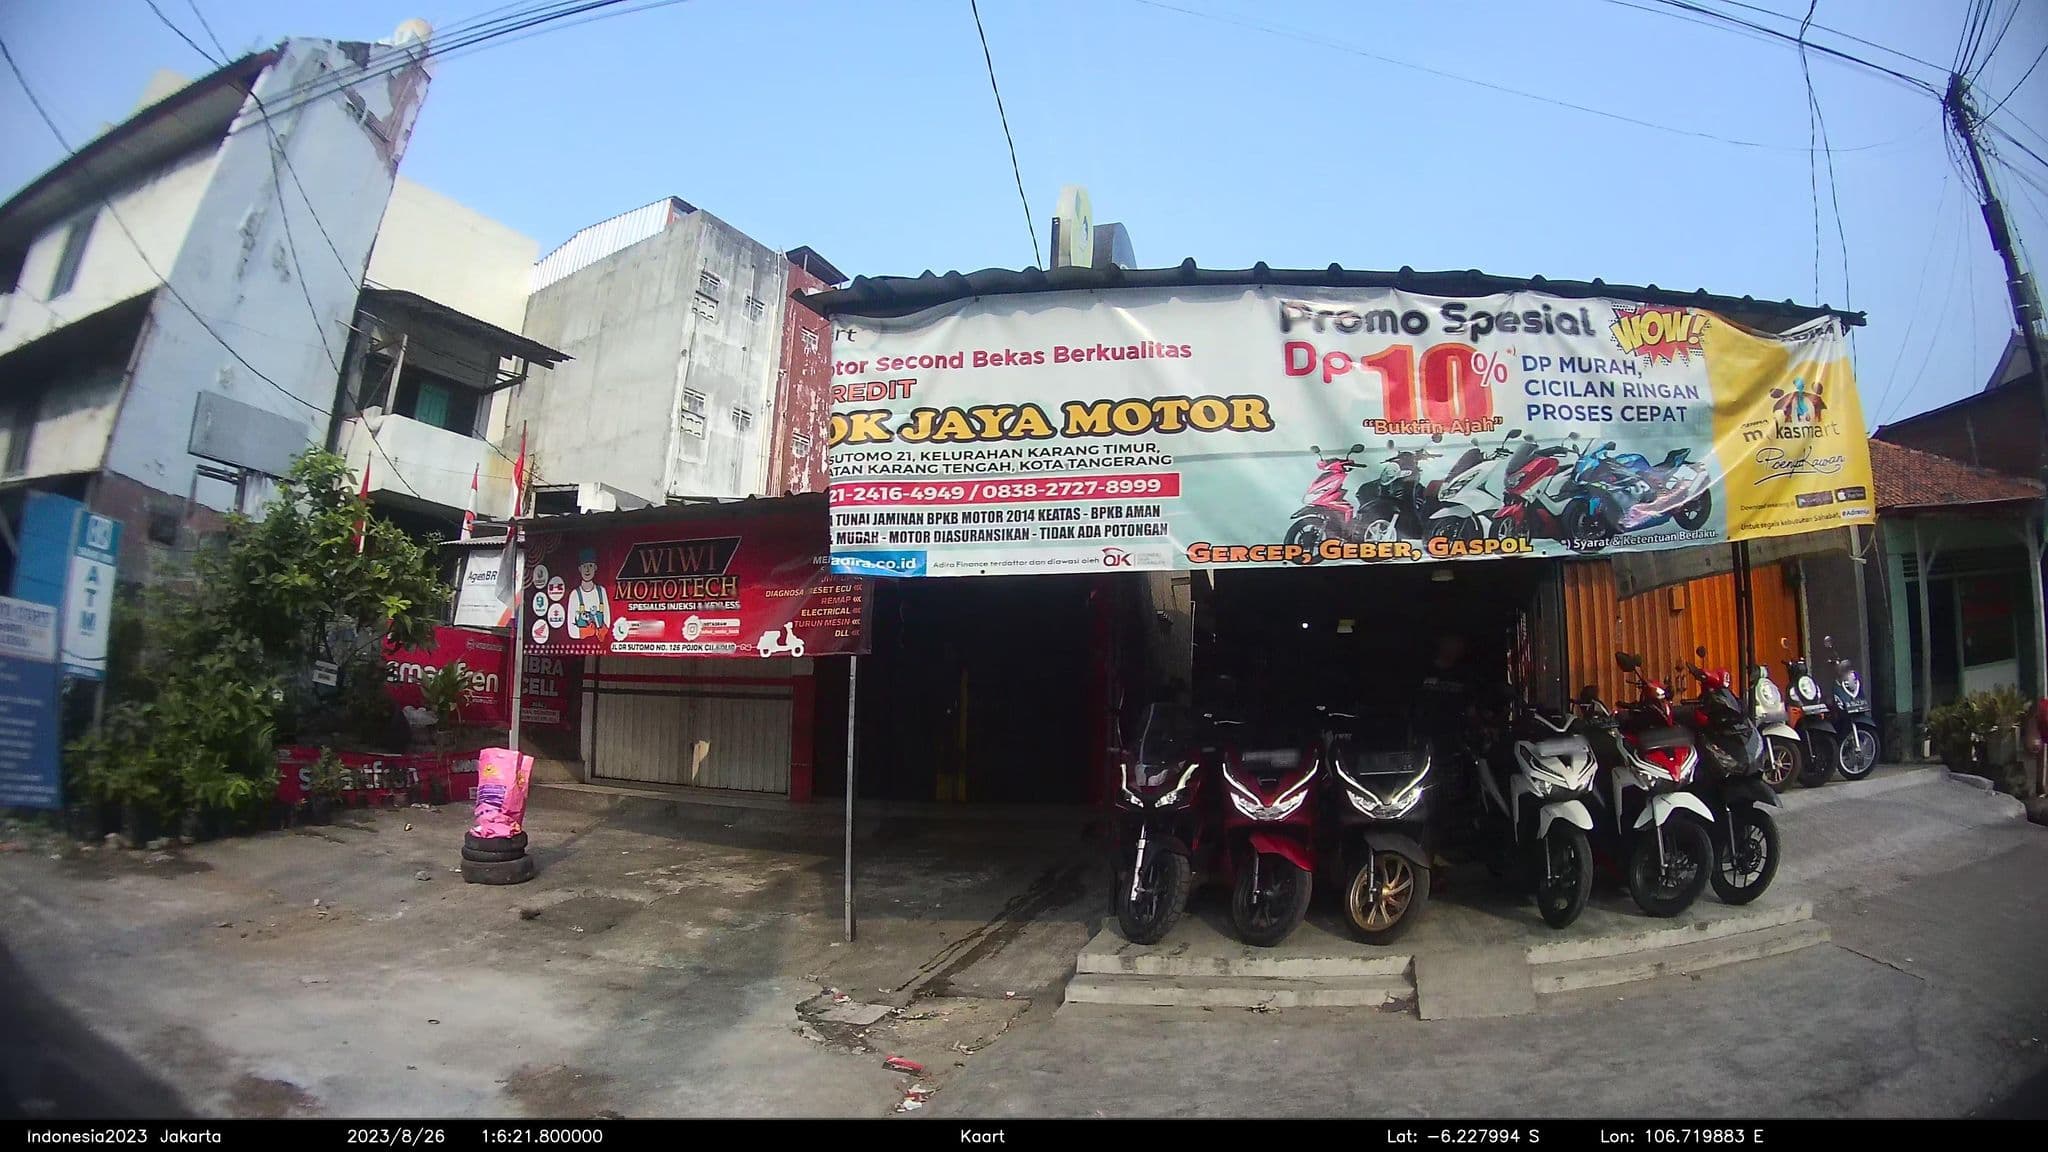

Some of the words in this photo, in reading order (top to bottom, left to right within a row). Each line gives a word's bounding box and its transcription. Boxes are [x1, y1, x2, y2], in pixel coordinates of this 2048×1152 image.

[1279, 301, 1430, 335] Promo
[1441, 302, 1596, 342] Spesial
[1610, 311, 1706, 354] WOW!
[832, 359, 868, 376] tor
[973, 349, 1045, 367] Bekas
[1054, 341, 1192, 364] Berkualitas
[1284, 340, 1353, 383] Dp
[1522, 355, 1551, 372] DP
[1560, 356, 1642, 378] MURAH,
[1525, 379, 1614, 397] CICILAN
[1623, 383, 1699, 399] RINGAN
[897, 403, 1058, 443] JAYA
[1061, 395, 1275, 438] MOTOR
[1527, 404, 1613, 422] PROSES
[1621, 406, 1687, 423] CEPAT
[1775, 420, 1840, 439] kasmart
[829, 452, 892, 465] SUTOMO
[897, 451, 915, 462] 21,
[920, 448, 1022, 462] KELURAHAN
[1028, 445, 1099, 458] KARANG
[1104, 443, 1160, 455] TIMUR,
[868, 463, 938, 474] KARANG
[943, 461, 1015, 475] TENGAH,
[1020, 459, 1063, 471] KOTA
[1067, 455, 1172, 469] TANGERANG
[982, 479, 1161, 499] 0838-2727-8999
[836, 513, 870, 527] TUNAI
[872, 512, 924, 526] JAMINAN
[927, 511, 958, 525] BPKB
[961, 511, 1003, 524] MOTOR
[1006, 510, 1035, 523] 2014
[1038, 508, 1081, 521] KEATAS
[1091, 506, 1123, 520] BPKB
[1126, 505, 1160, 518] AMAN
[836, 531, 879, 545] MUDAH
[889, 530, 930, 544] MOTOR
[934, 528, 1029, 543] DIASURANSIKAN
[1040, 526, 1075, 540] TIDAK
[1078, 525, 1100, 539] ADA
[1104, 523, 1168, 537] POTONGAN
[1573, 538, 1609, 550] Syarat
[1612, 537, 1621, 546] &
[1623, 533, 1677, 546] Ketentuan
[639, 546, 717, 574] WIWI
[1187, 541, 1312, 564] GERCEP,
[1319, 539, 1422, 561] GEBER,
[1428, 536, 1533, 558] GASPOL
[615, 576, 738, 600] MOTOTECH
[765, 588, 804, 598] DIAGNOSA
[811, 586, 834, 595] ESET
[836, 584, 851, 593] ECU
[628, 602, 666, 611] SPESIALIS
[667, 602, 696, 610] INJEKSI
[821, 596, 851, 605] REMAP
[801, 607, 850, 617] ELECTRICAL
[794, 619, 824, 628] TURUN
[824, 618, 850, 627] MESIN
[834, 629, 850, 637] DLL
[628, 643, 654, 651] SUTOMO
